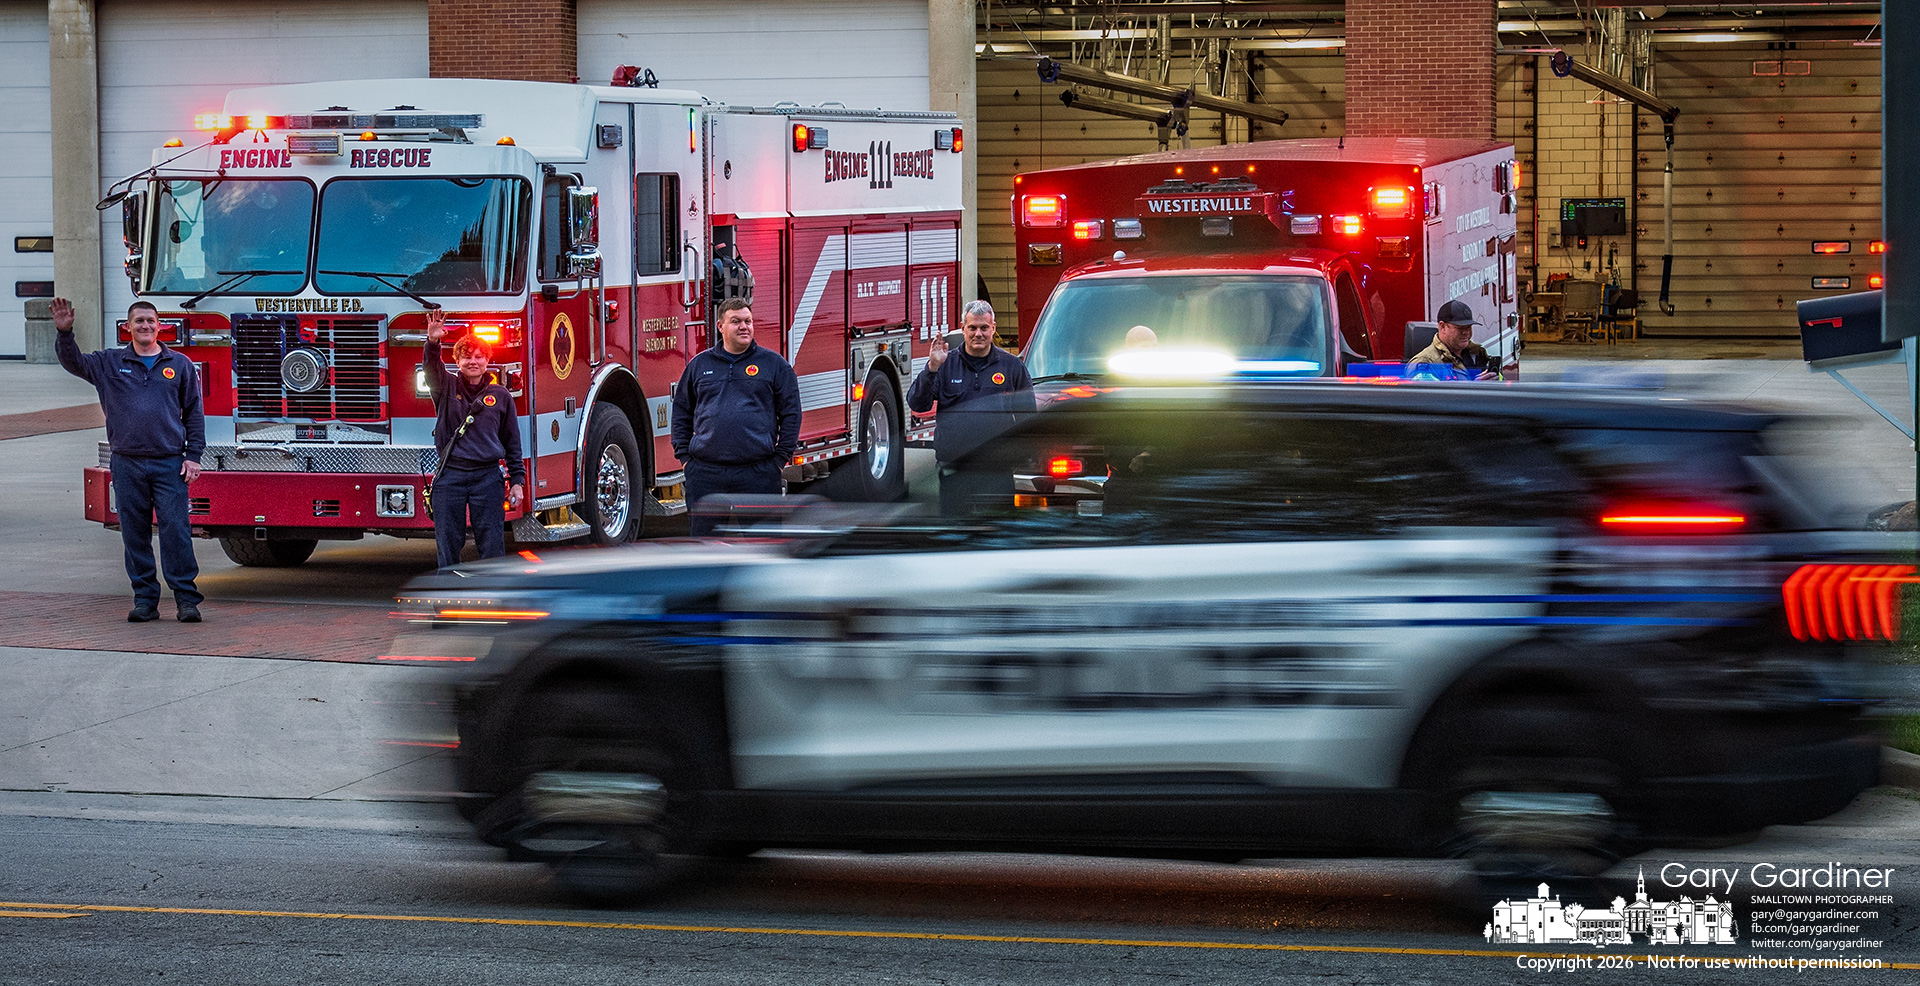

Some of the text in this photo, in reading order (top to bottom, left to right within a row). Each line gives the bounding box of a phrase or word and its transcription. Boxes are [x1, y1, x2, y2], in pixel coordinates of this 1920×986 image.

[219, 148, 432, 168] ENGINE RESCUE
[824, 140, 934, 189] ENGINE 111 RESCUE
[1148, 197, 1252, 213] WESTERVILLE
[255, 298, 365, 312] WESTERVILLE F.D.
[920, 276, 949, 340] 111
[642, 316, 671, 333] WESTERVILLE
[645, 337, 666, 352] BLENDON
[657, 403, 668, 429] 111
